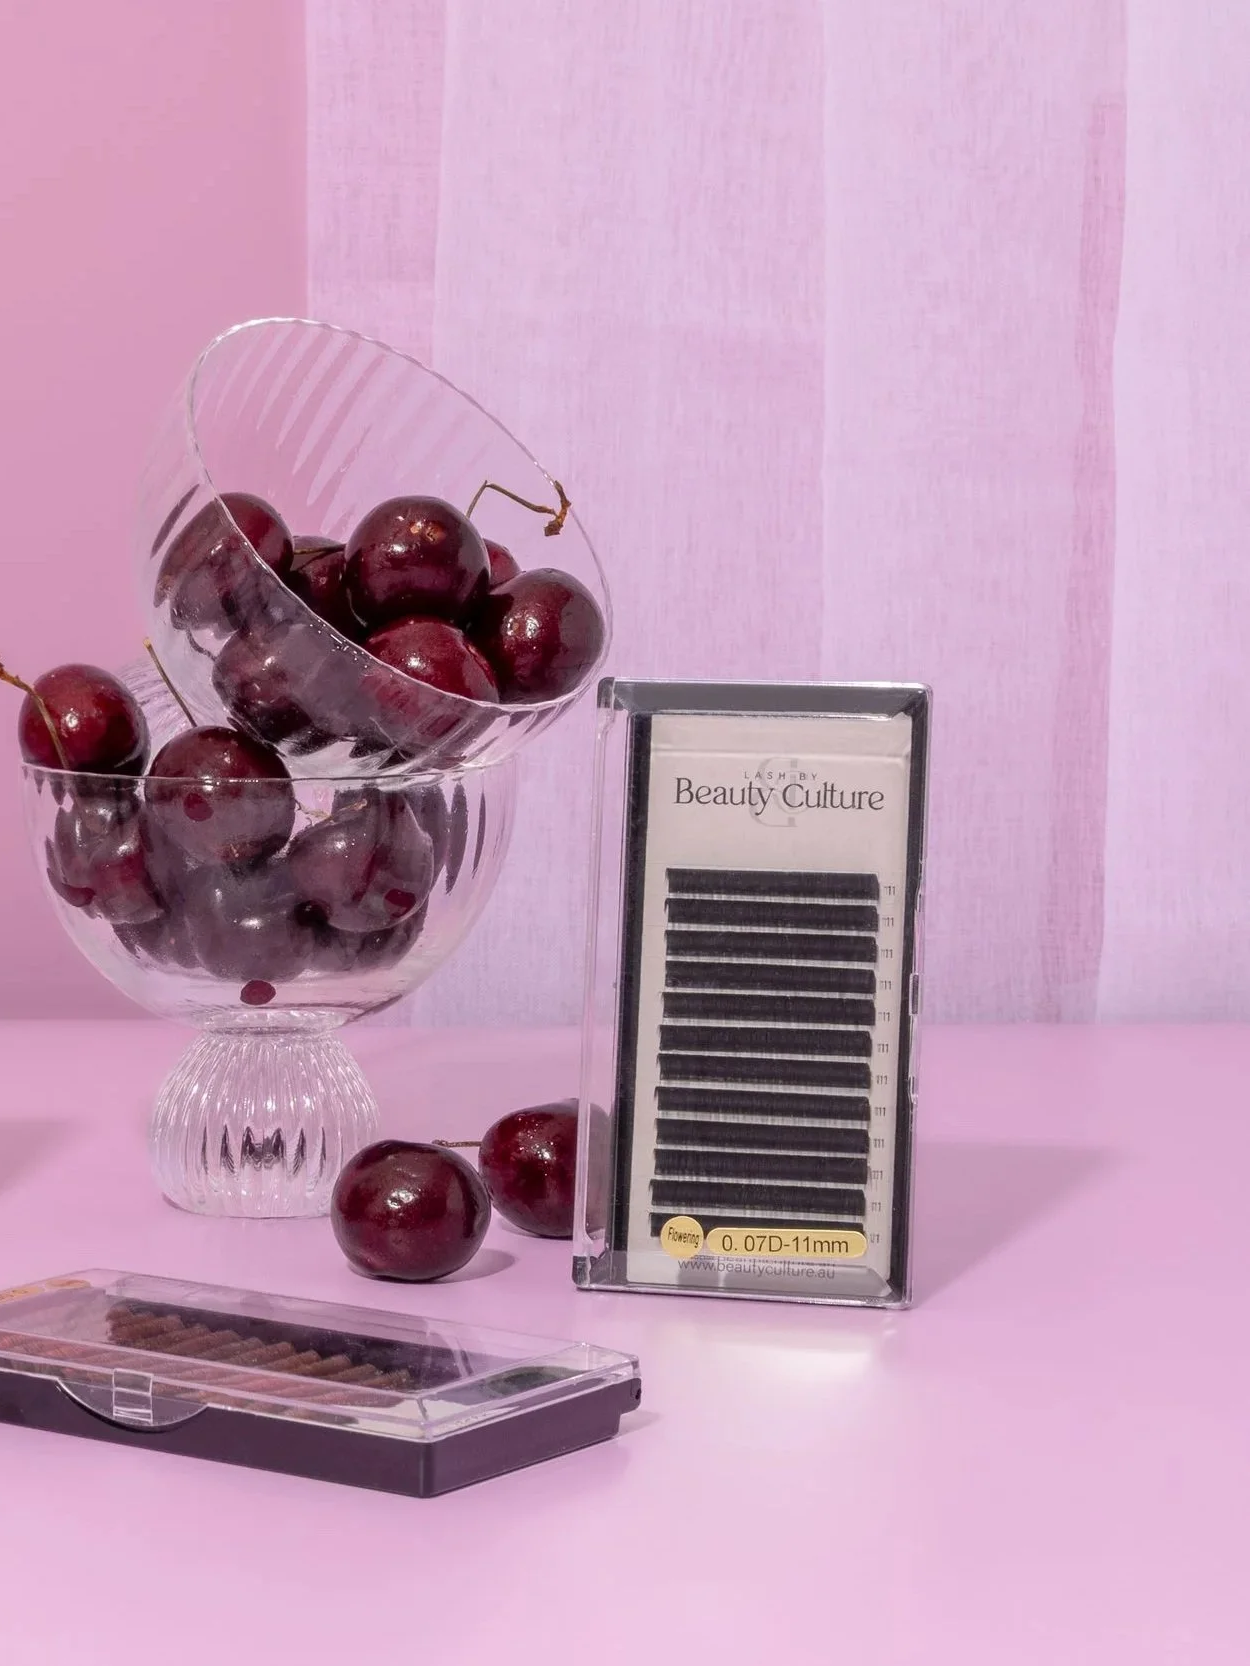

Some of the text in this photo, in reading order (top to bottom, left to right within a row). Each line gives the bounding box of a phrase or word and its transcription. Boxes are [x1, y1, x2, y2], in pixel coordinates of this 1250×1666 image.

[744, 770, 818, 782] LASH BY
[673, 776, 885, 817] Beauty Culture
[667, 1226, 700, 1249] Flowering
[678, 1258, 836, 1279] www.beautyculture.au
